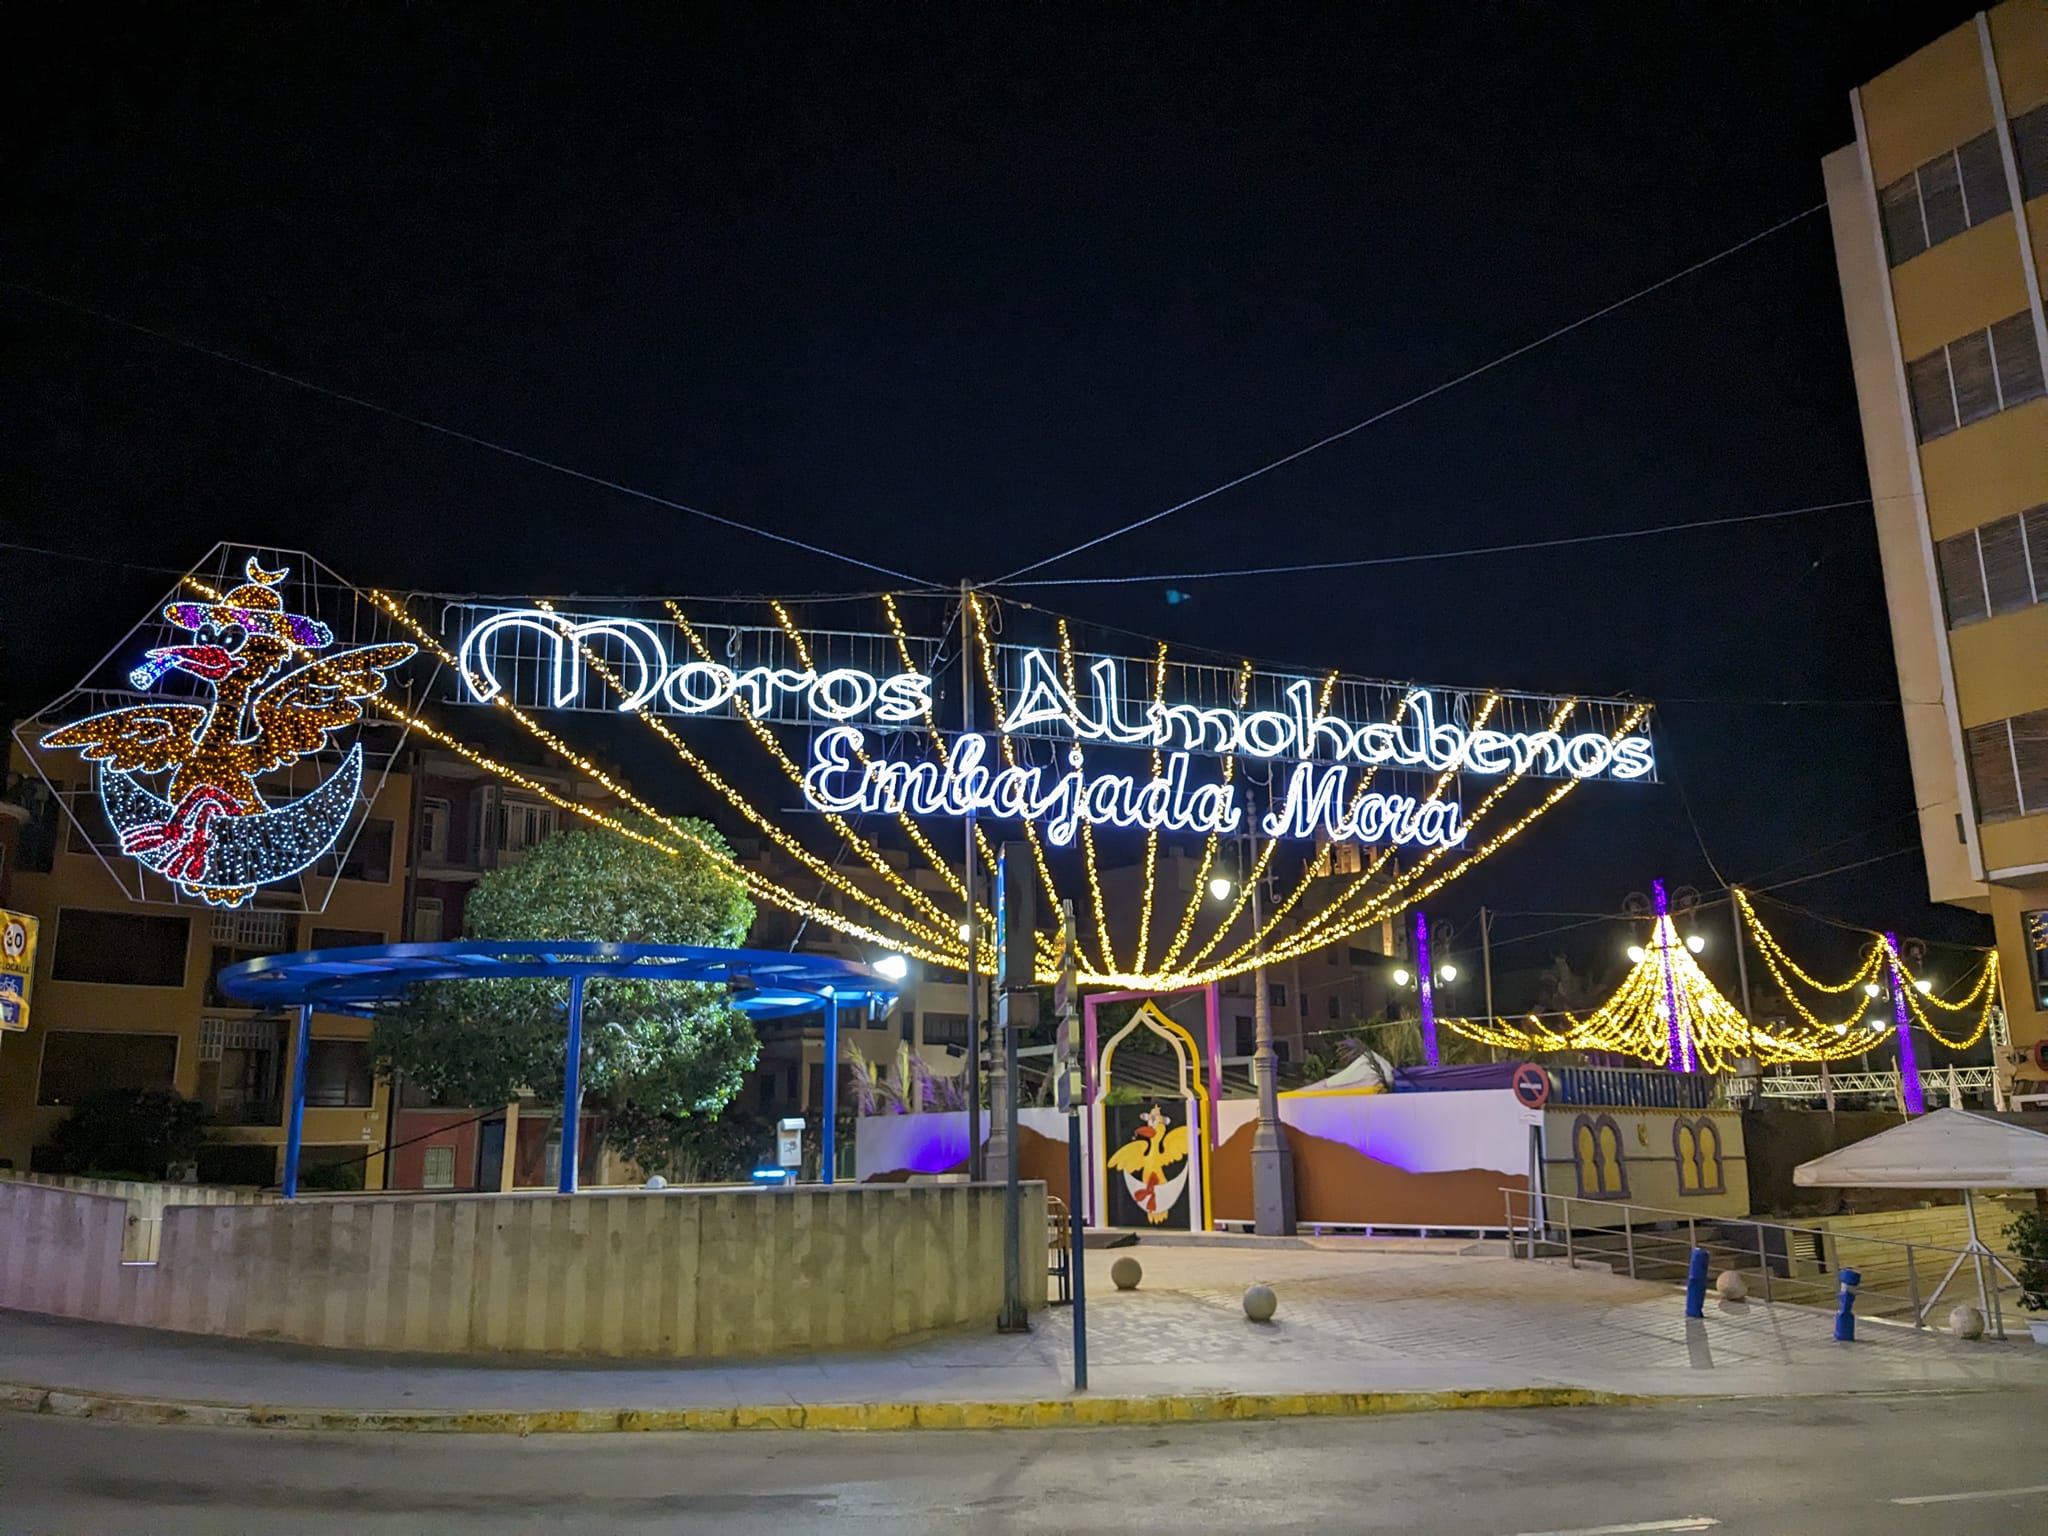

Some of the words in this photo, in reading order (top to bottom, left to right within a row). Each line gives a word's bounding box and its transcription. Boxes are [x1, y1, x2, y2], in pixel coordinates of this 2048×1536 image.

[459, 609, 933, 722] Moros
[803, 726, 1242, 847] Embajada
[1262, 761, 1469, 847] Mora
[0, 961, 30, 975] LOCALLE
[6, 930, 23, 949] 30
